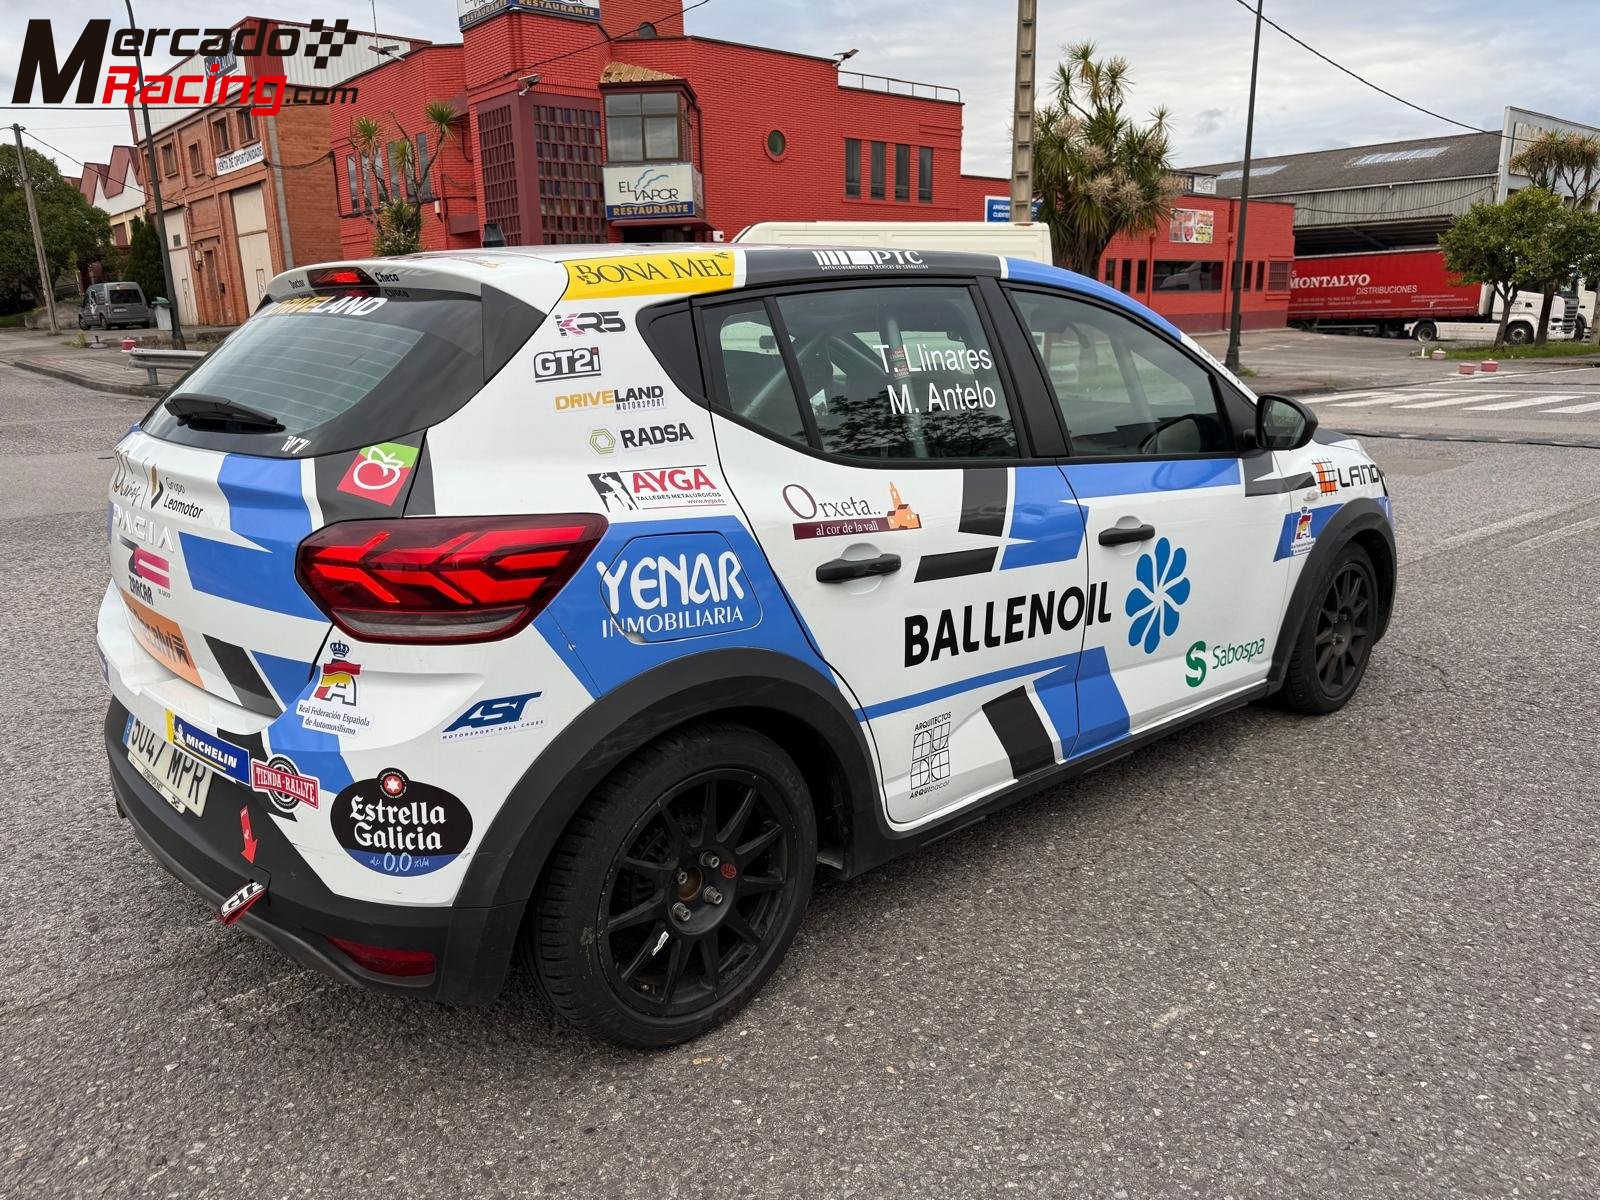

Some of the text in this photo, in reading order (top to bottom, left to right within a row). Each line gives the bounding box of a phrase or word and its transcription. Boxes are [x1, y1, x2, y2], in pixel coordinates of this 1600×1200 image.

[618, 181, 635, 193] EL
[634, 188, 679, 201] VAPOR
[612, 204, 689, 216] RESTAURANTE
[870, 250, 924, 265] PTC
[573, 256, 732, 286] BONA MEL
[1289, 274, 1371, 289] MONTALVO
[1356, 284, 1418, 295] DISTRIBUCIONES
[872, 344, 899, 374] T.
[902, 344, 992, 372] Llinares
[555, 386, 664, 411] DRIVELAND
[615, 399, 665, 411] MOTORSPORT
[887, 380, 996, 415] M. Antelo
[620, 422, 695, 449] RADSA
[632, 468, 717, 493] AYGA
[163, 493, 204, 519] Leomotor
[816, 520, 879, 536] al cor de la vall
[596, 550, 745, 615] YENAR
[601, 605, 744, 639] INMOBILIARIA
[904, 581, 1112, 668] BALLENOIL
[1212, 637, 1265, 670] Sabospa
[298, 704, 370, 727] Real Federación Española
[304, 717, 356, 735] de Automovilismo
[914, 711, 952, 732] ARQUITECTOS
[442, 728, 495, 740] MOTORSPORT
[185, 734, 238, 768] MICHELIN
[350, 795, 447, 825] Estrella
[354, 820, 443, 850] Galicia
[383, 852, 413, 873] 0,0
